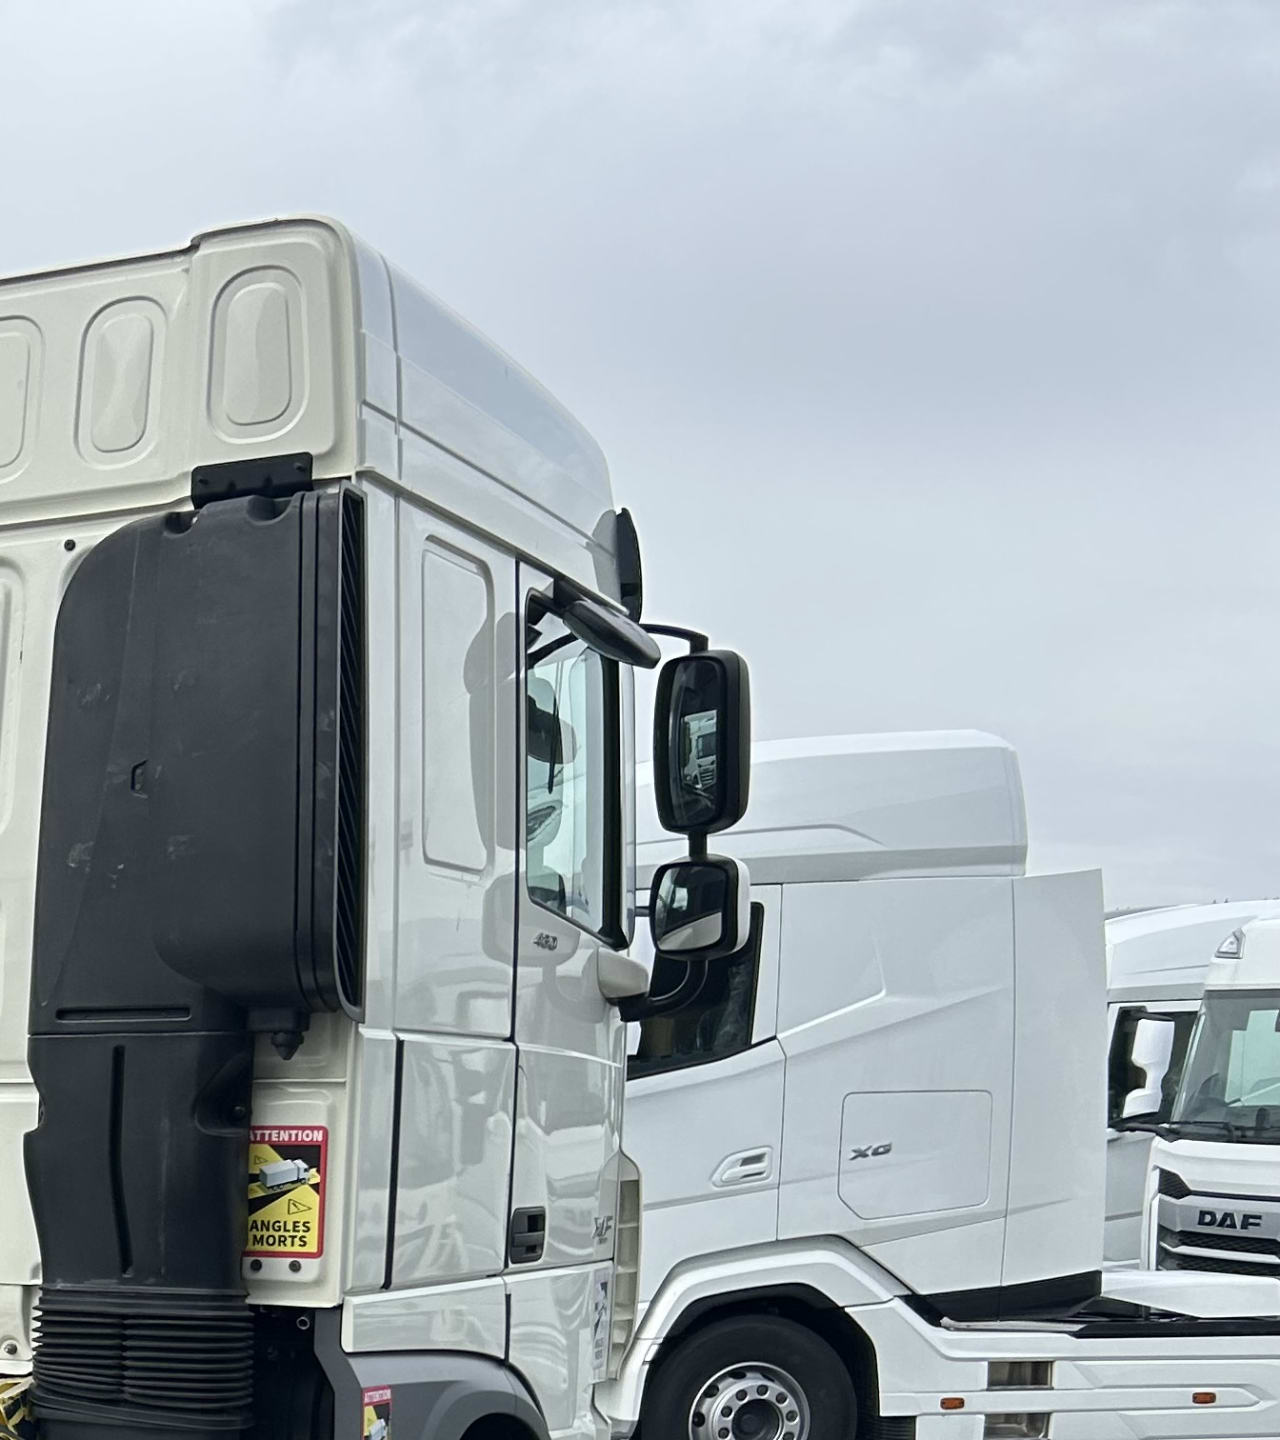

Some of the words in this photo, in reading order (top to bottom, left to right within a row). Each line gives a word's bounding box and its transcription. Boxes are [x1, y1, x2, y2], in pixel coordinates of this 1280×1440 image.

[249, 1220, 312, 1233] ANGLES
[1197, 1210, 1263, 1230] DAF
[252, 1234, 308, 1247] MORTS
